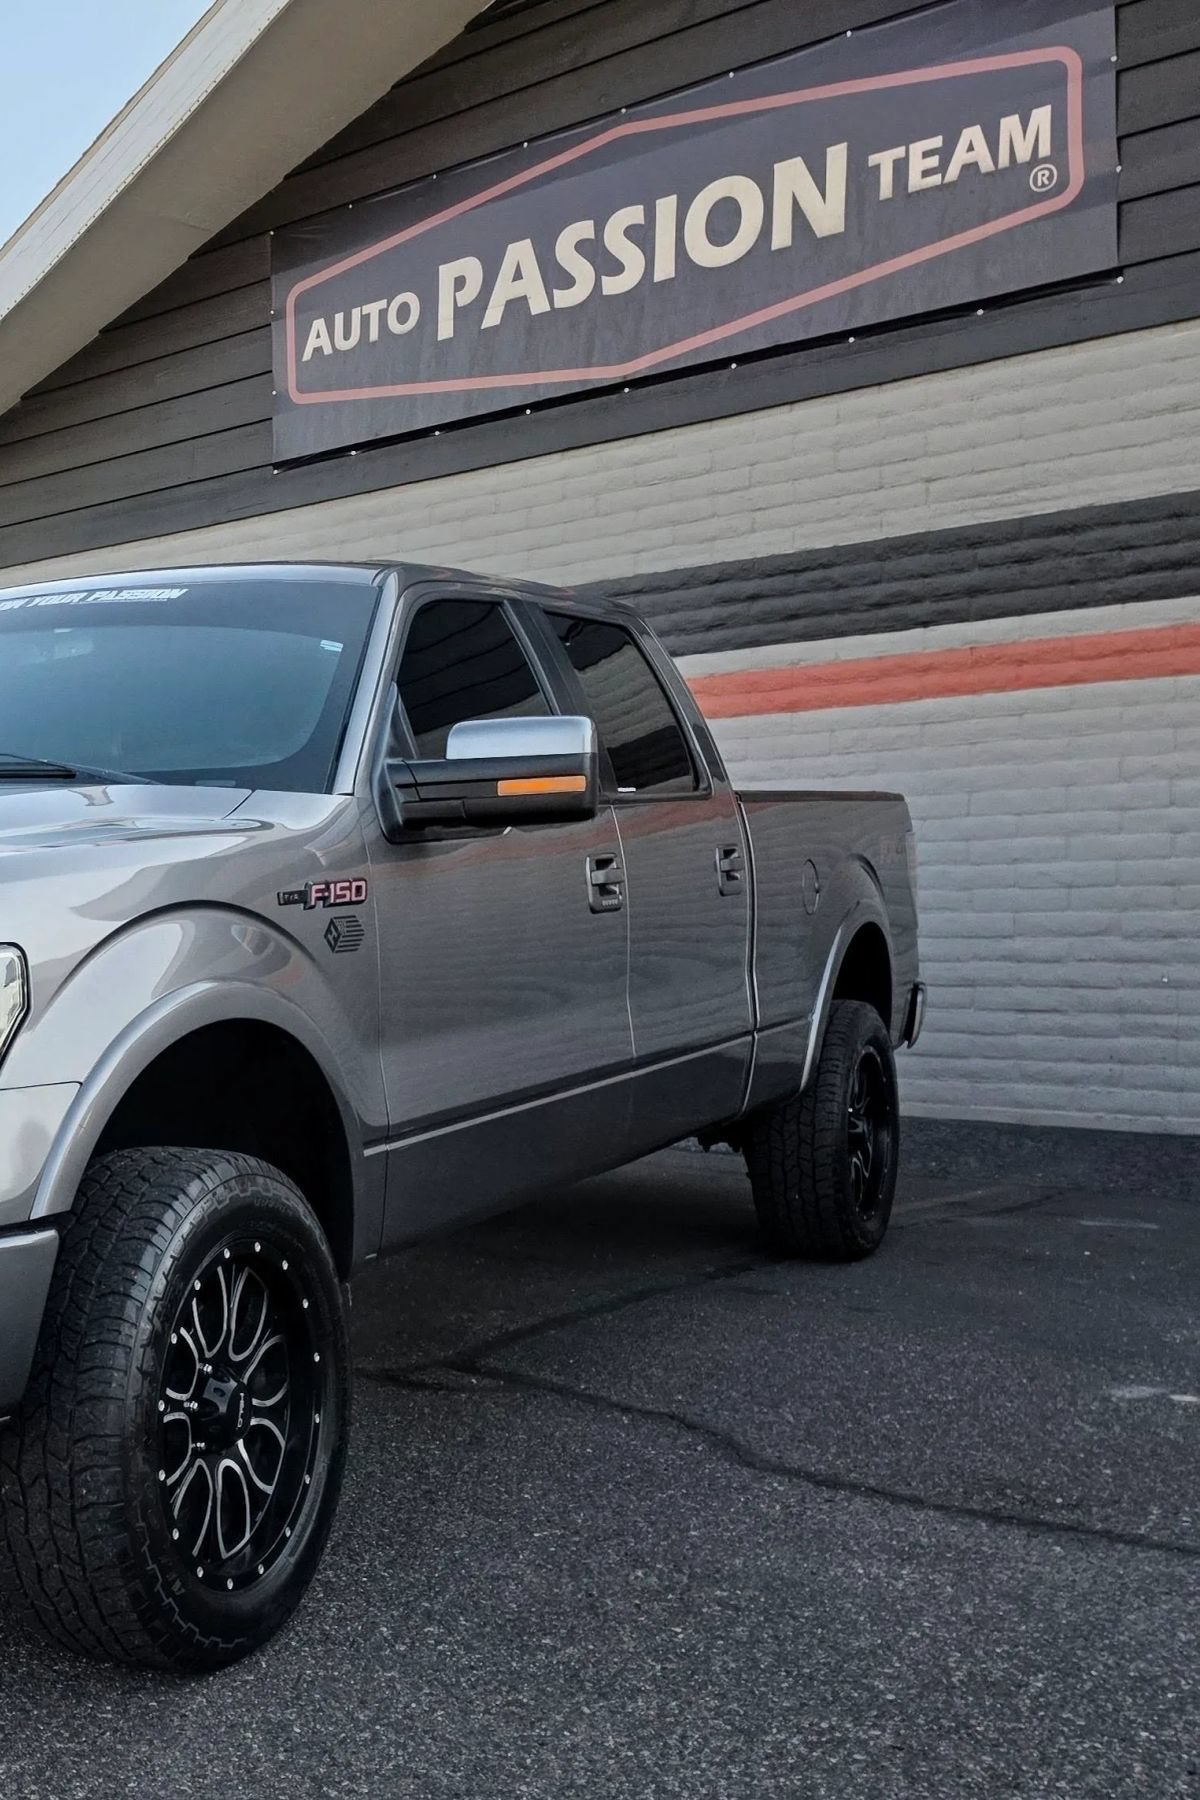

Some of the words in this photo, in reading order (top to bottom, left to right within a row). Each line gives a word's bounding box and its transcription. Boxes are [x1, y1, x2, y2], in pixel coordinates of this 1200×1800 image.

[302, 291, 420, 363] AUTO
[436, 142, 848, 342] PASSION
[868, 104, 1054, 203] TEAM
